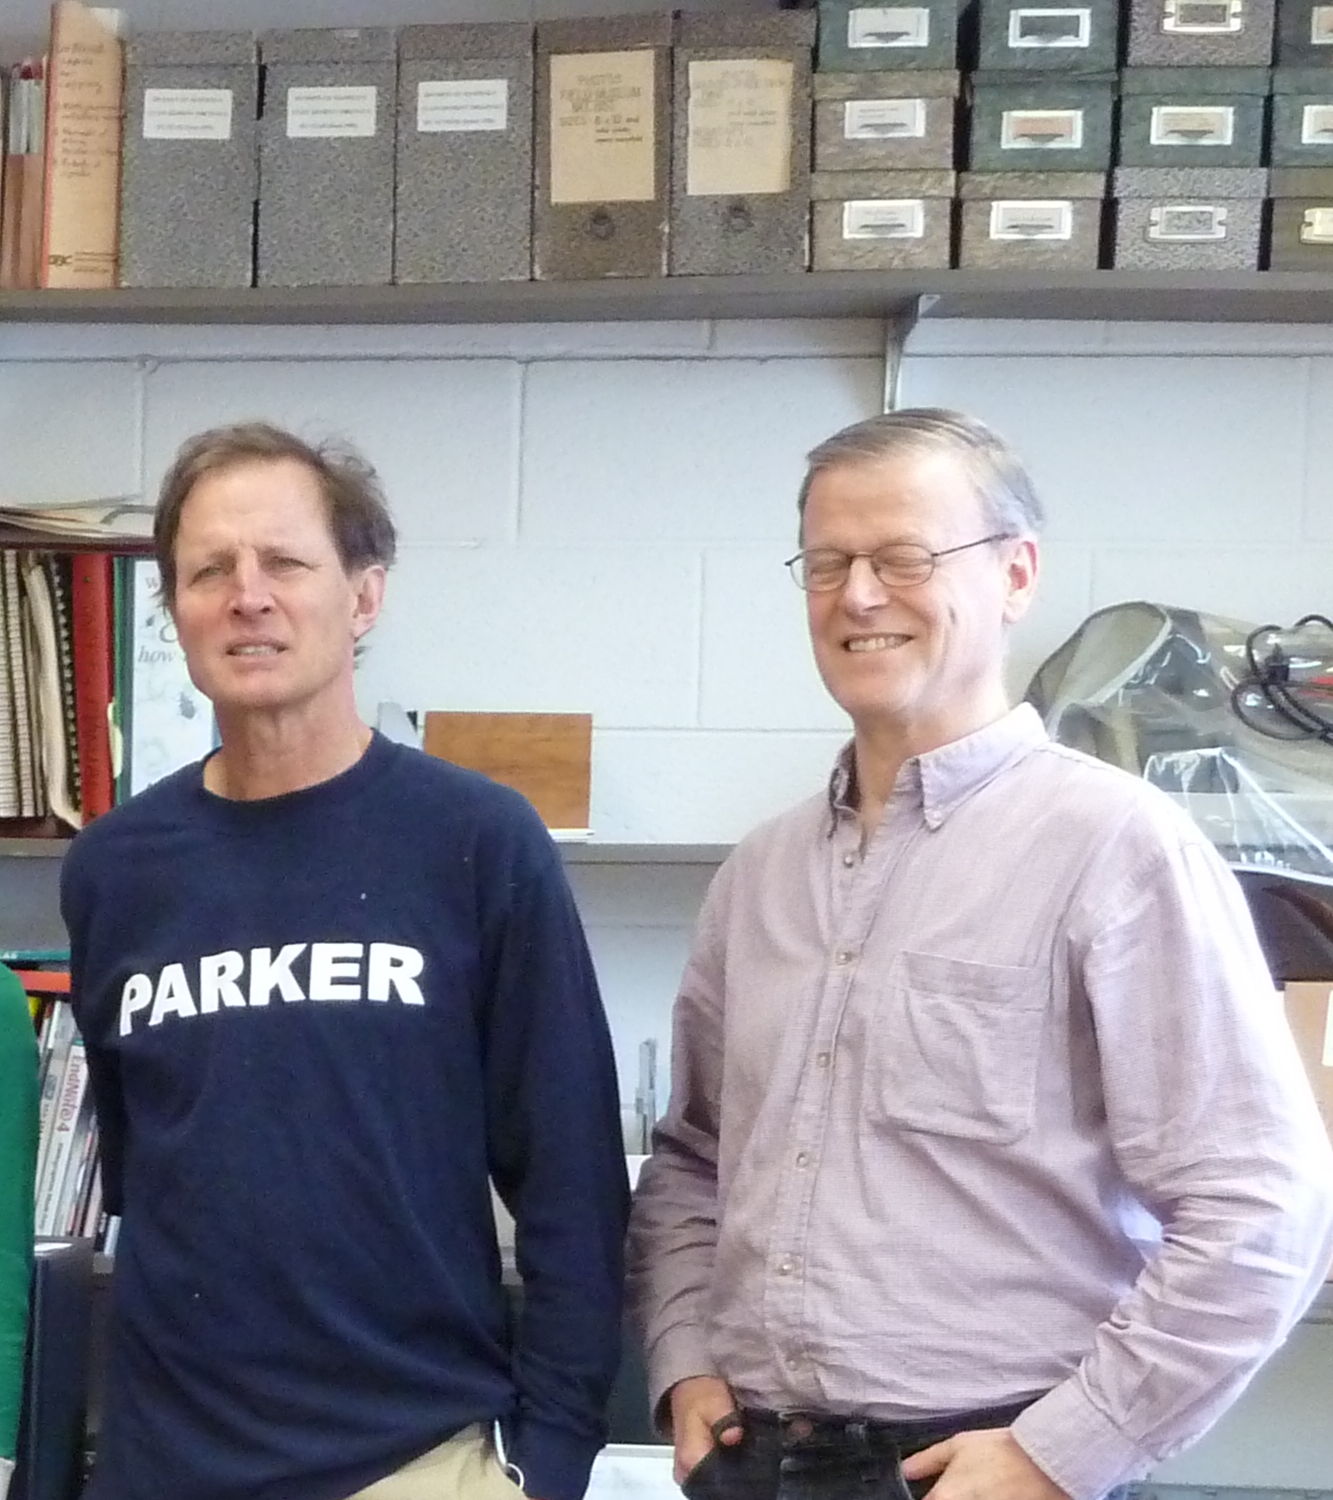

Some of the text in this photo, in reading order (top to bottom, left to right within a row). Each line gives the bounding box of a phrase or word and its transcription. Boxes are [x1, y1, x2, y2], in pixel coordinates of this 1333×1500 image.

[138, 646, 175, 663] how
[119, 942, 425, 1036] PARKER
[56, 1121, 71, 1133] 4
